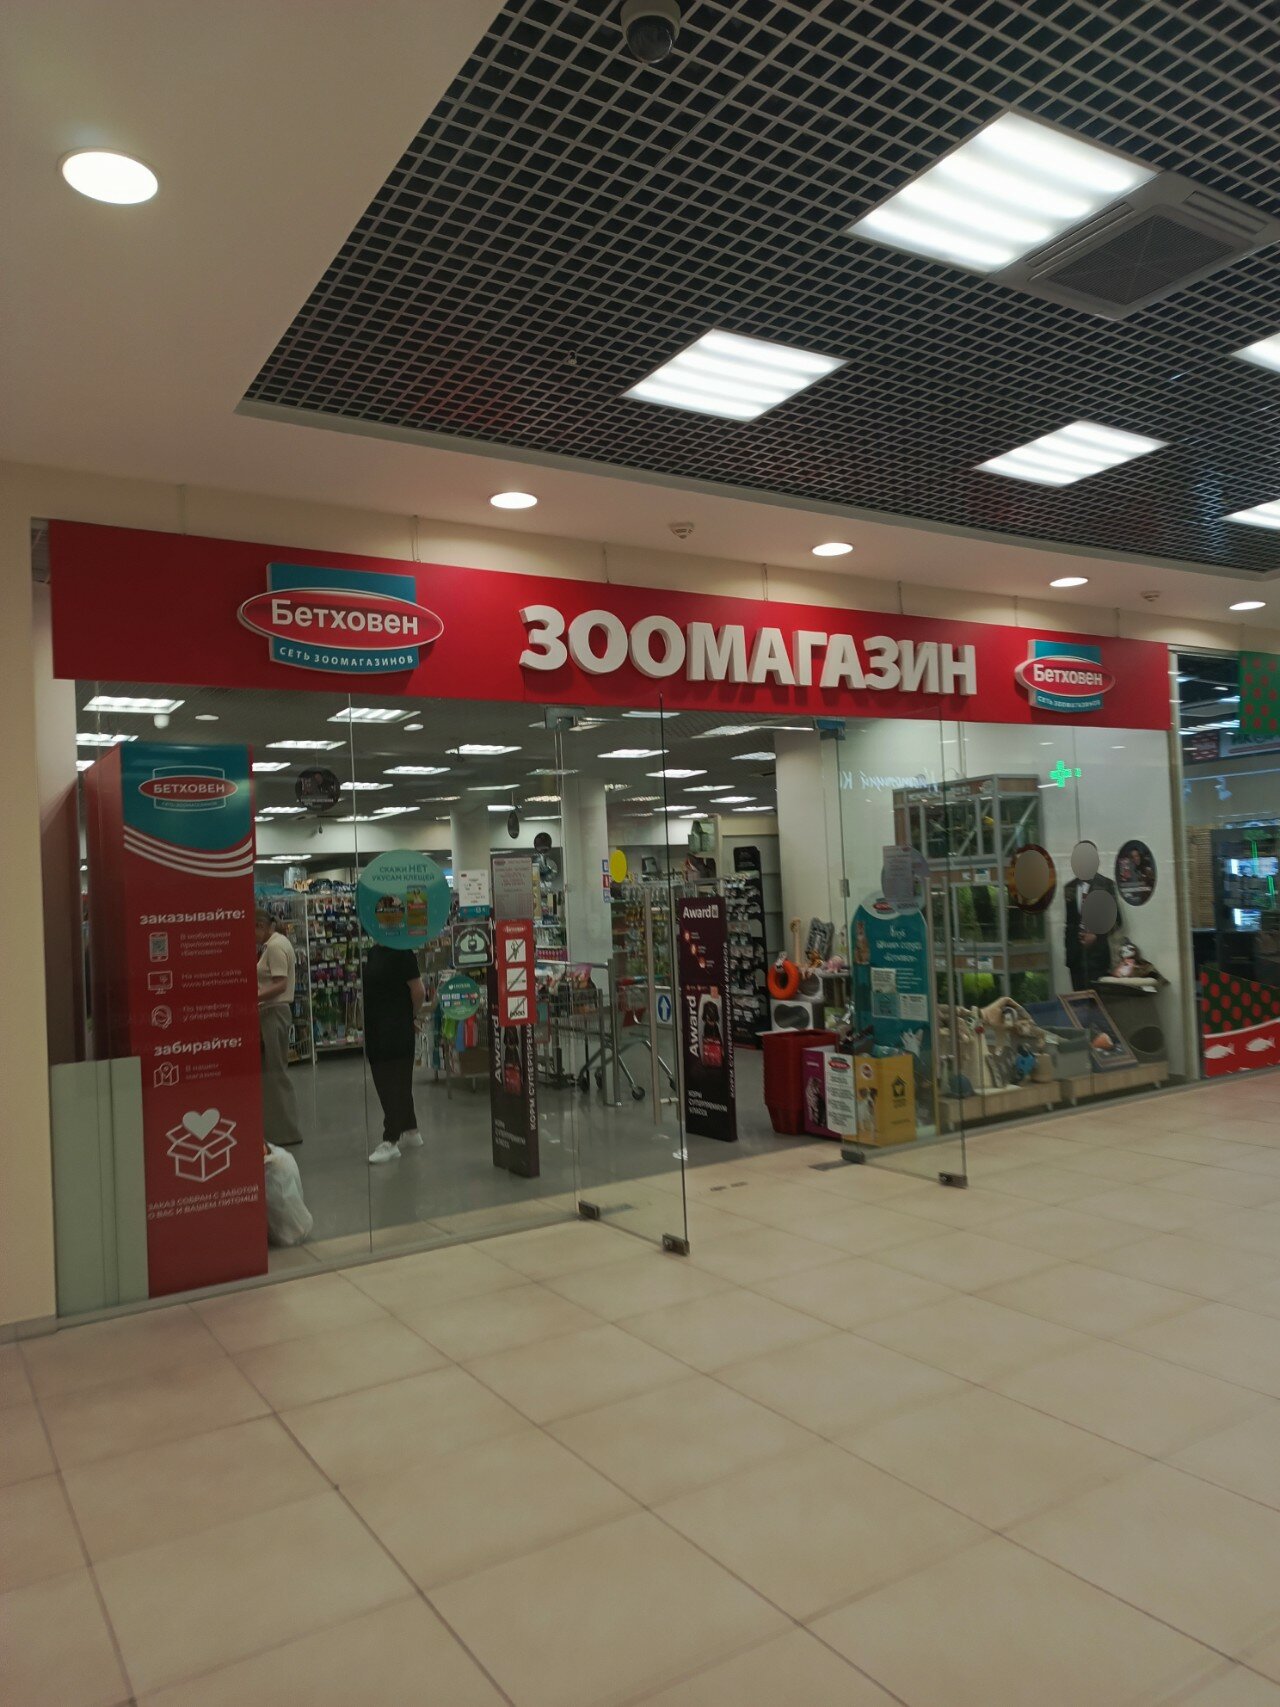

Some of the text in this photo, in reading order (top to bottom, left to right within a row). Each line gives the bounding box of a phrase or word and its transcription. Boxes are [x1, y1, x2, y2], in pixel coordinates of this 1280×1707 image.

[272, 599, 418, 635] Бетховен
[280, 646, 414, 667] СЕТЬ ЗООМАГАЗИНОВ
[519, 604, 977, 695] ЗООМАГАЗИН
[1033, 664, 1103, 686] Бетховен
[153, 783, 225, 794] БЕТХОВЕН
[408, 863, 428, 873] НЕТ
[139, 908, 246, 925] заказывайте:
[683, 905, 711, 920] Award
[687, 995, 699, 1057] Award
[154, 1037, 242, 1056] забирайте:
[492, 1014, 502, 1084] Award
[528, 1098, 537, 1131] КОРМ
[148, 1199, 175, 1211] ЗАКАЗ
